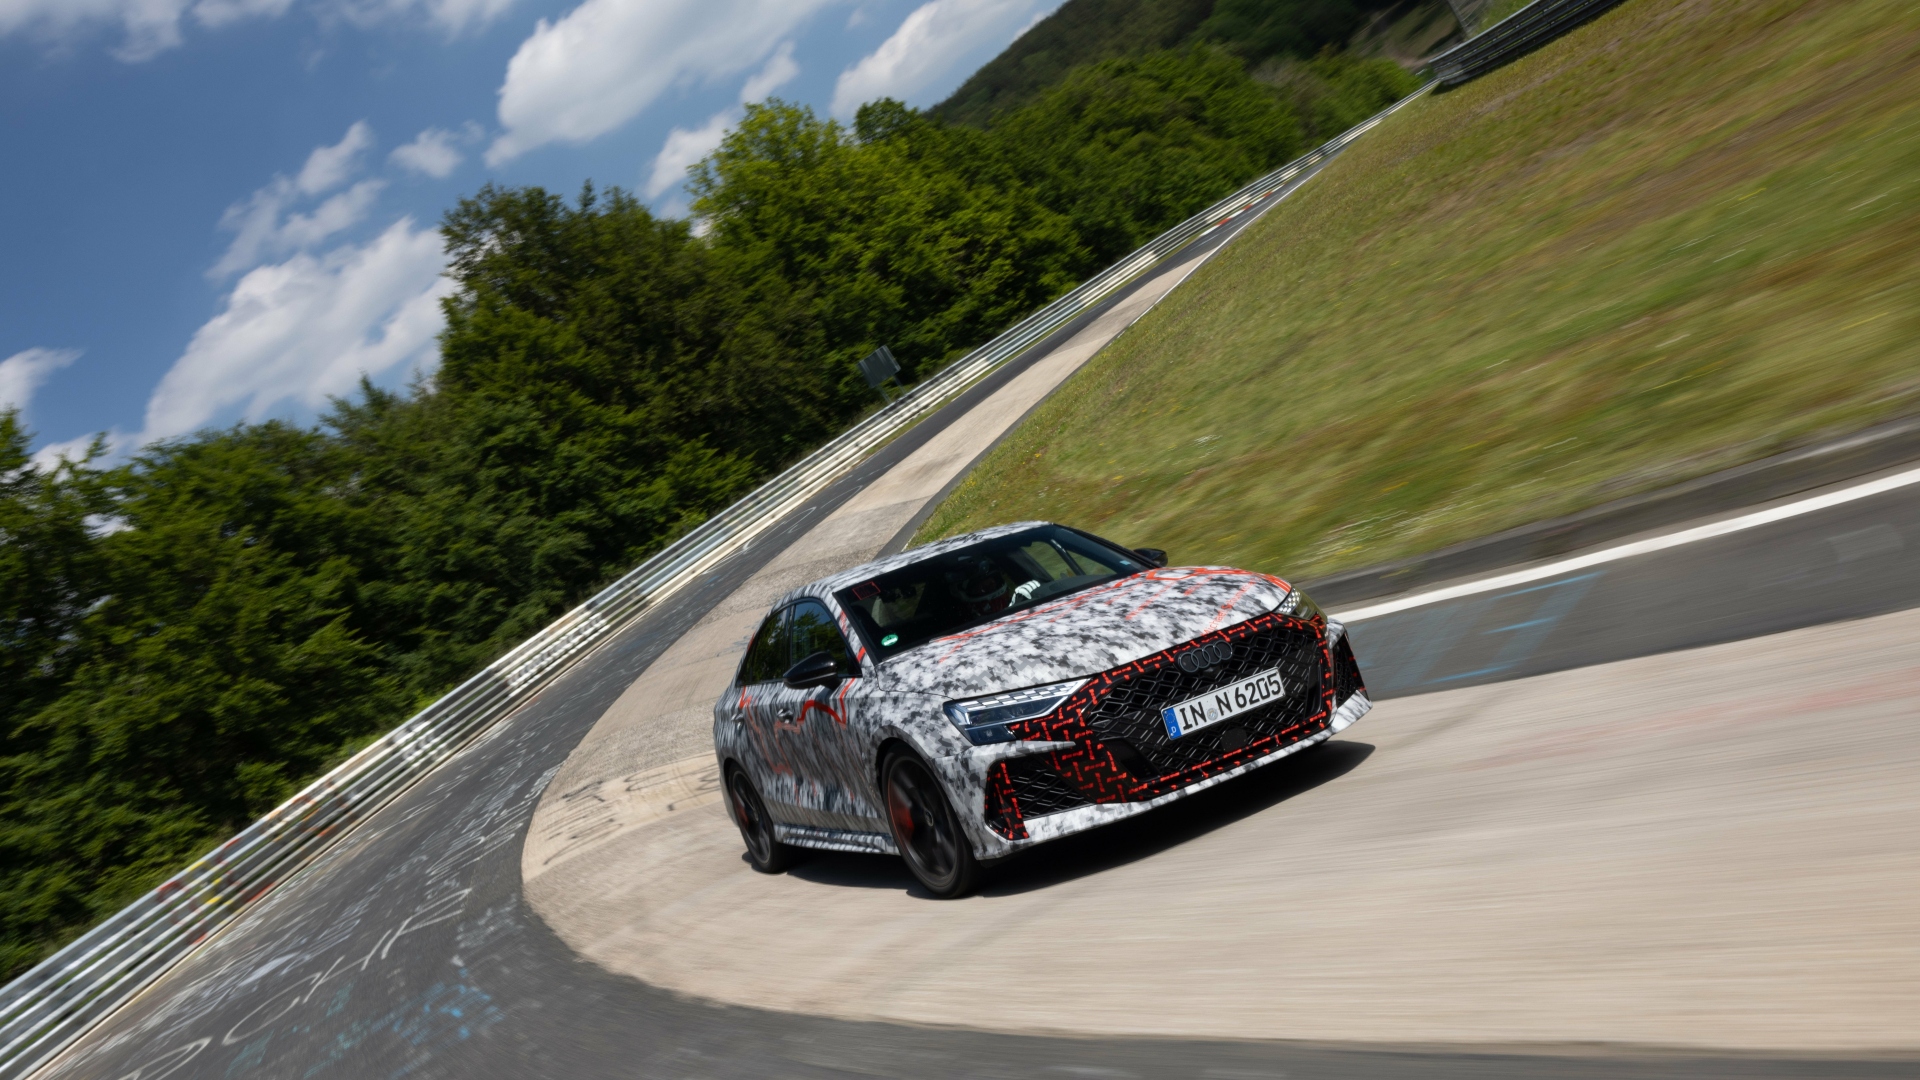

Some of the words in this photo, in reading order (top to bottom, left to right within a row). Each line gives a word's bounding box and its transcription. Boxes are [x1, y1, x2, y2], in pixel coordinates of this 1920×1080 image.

[1179, 701, 1207, 731] IN
[1215, 691, 1233, 716] N
[1235, 672, 1282, 709] 6205
[1171, 726, 1177, 734] D
